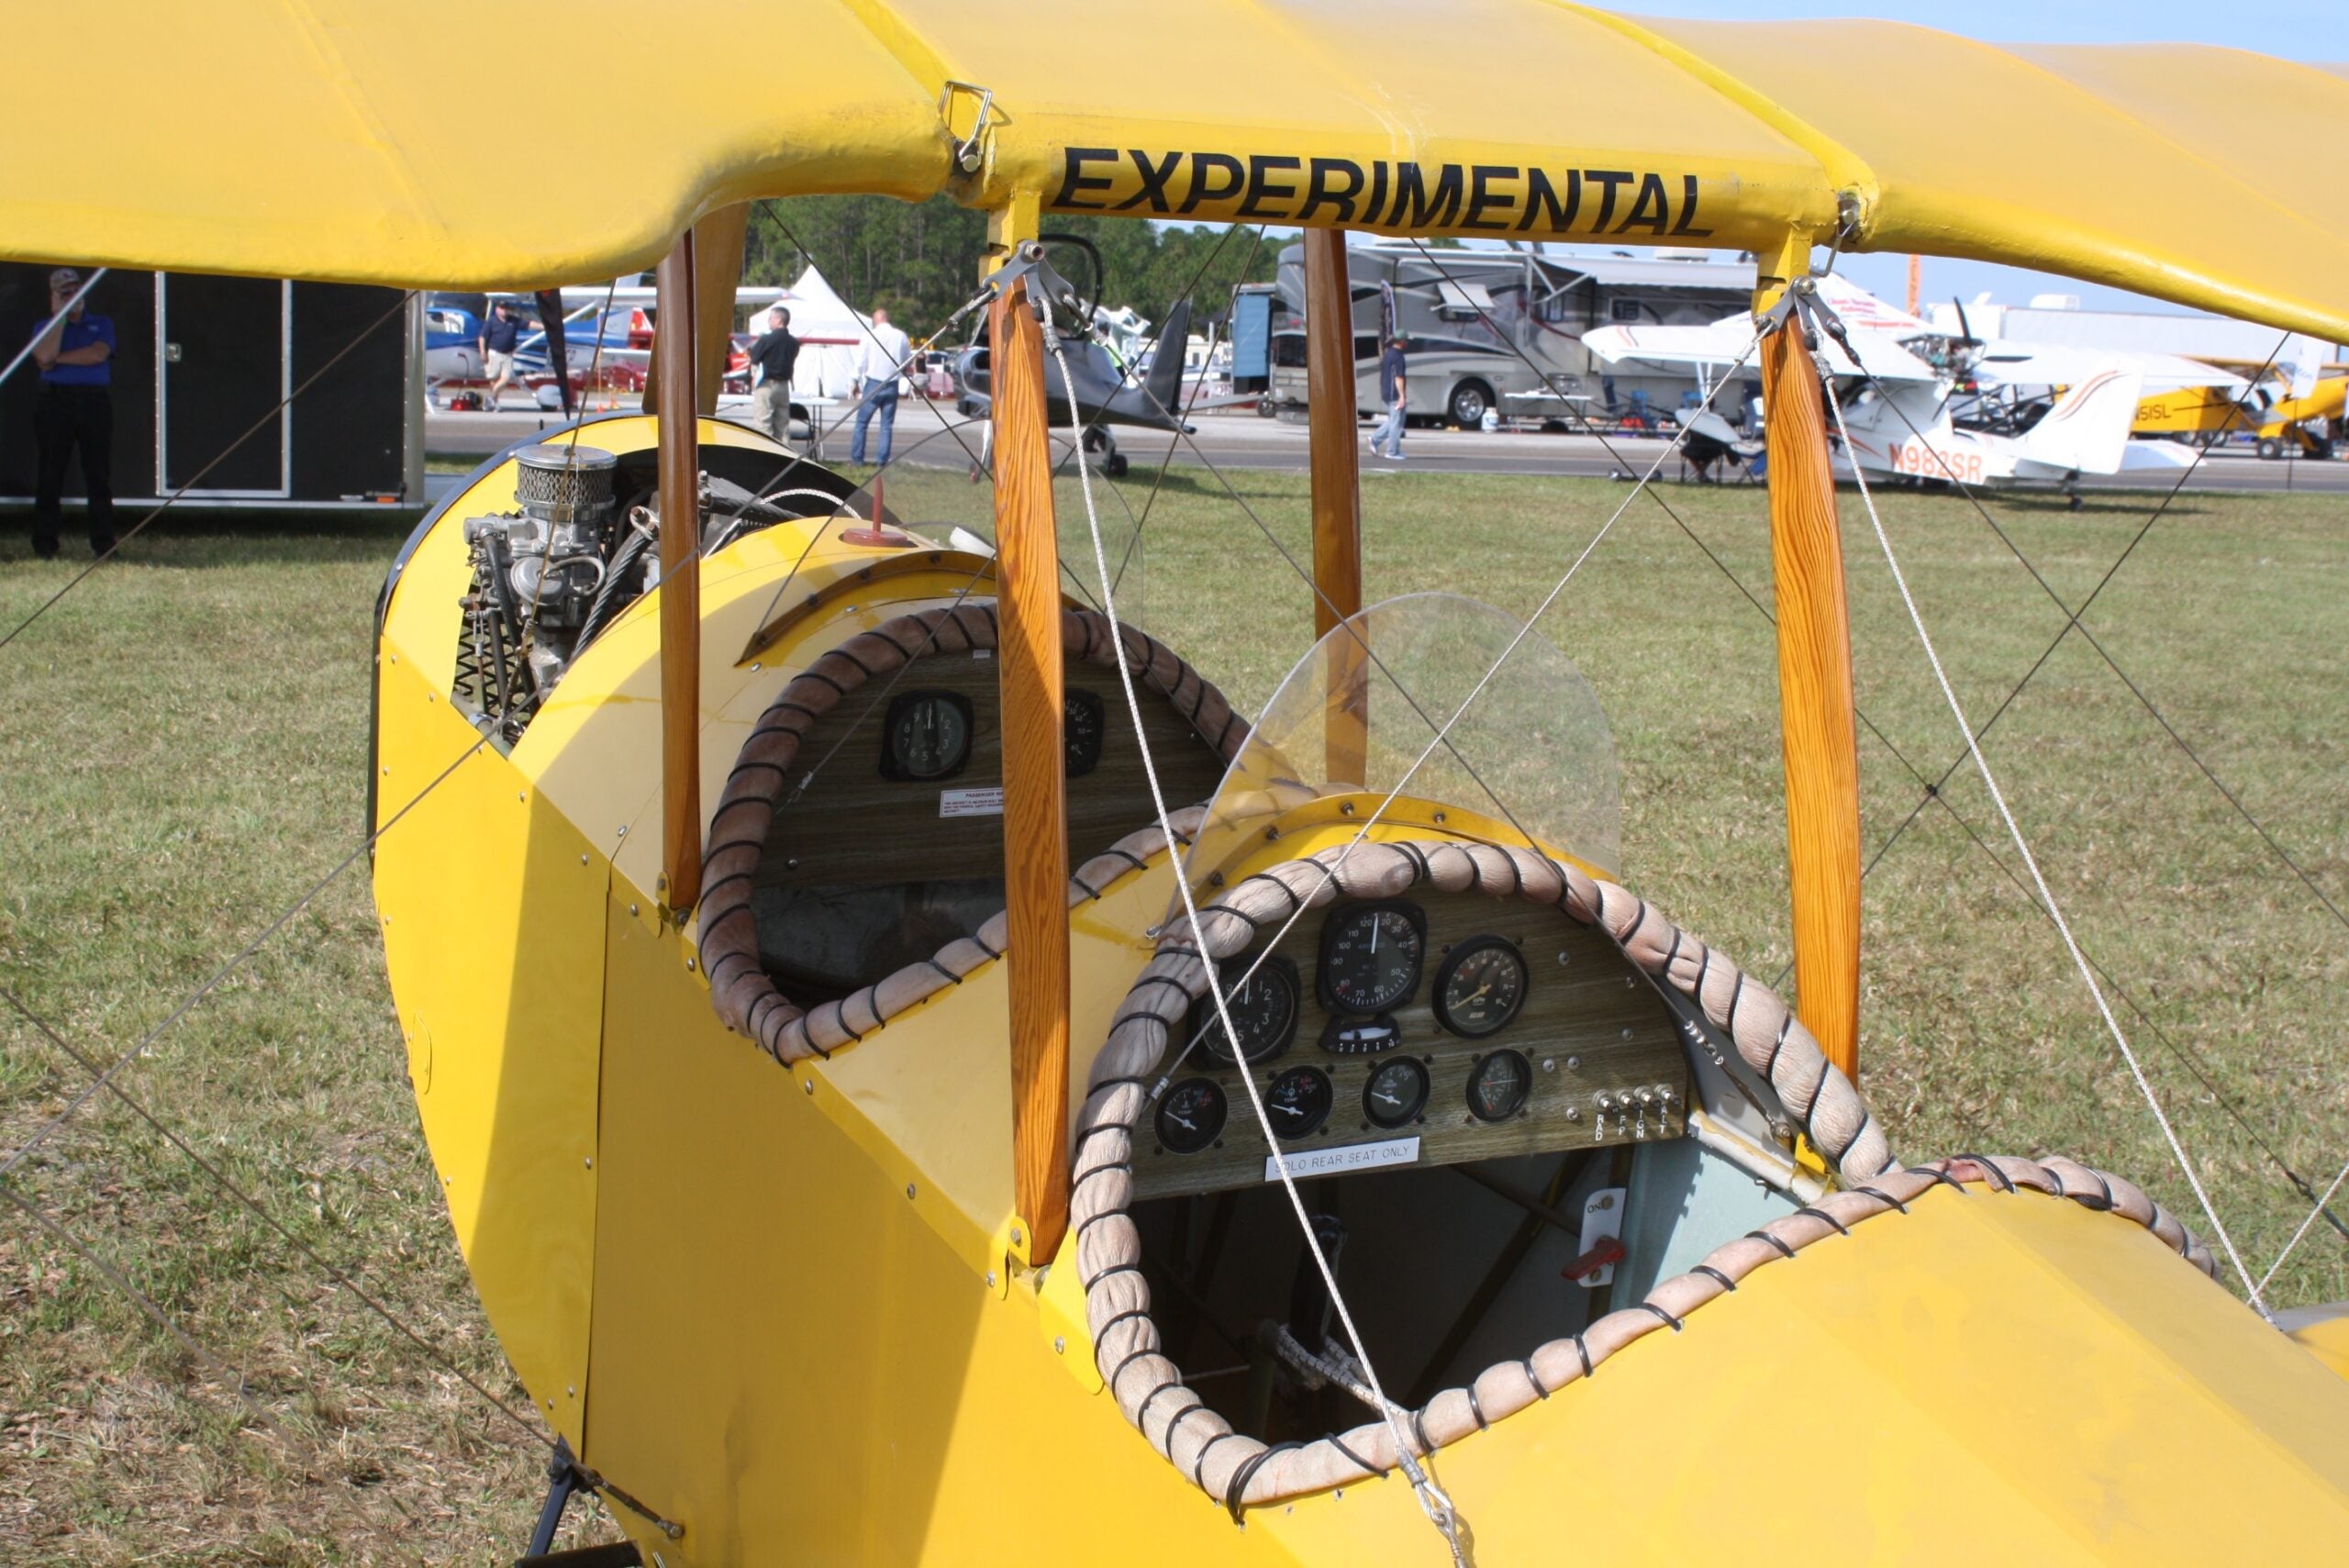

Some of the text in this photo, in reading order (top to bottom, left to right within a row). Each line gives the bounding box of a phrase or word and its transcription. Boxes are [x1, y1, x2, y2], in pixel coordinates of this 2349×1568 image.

[1052, 147, 1715, 238] EXPERIMENTAL
[1888, 442, 1982, 483] N982SR
[913, 712, 920, 723] 9
[943, 719, 951, 729] 2
[903, 723, 911, 734] 8
[903, 738, 910, 748] 7
[941, 739, 949, 750] 3
[909, 748, 917, 758] 6
[921, 751, 929, 762] 5
[1264, 988, 1273, 1001] 2
[1262, 1013, 1270, 1025] 3
[1252, 1022, 1260, 1035] 4
[1237, 1029, 1245, 1042] 5
[1636, 1109, 1644, 1139] IGN
[1659, 1105, 1668, 1134] ALT
[1595, 1114, 1605, 1141] RAD
[1311, 1154, 1342, 1168] REAR
[1348, 1150, 1377, 1163] SEAT
[1382, 1146, 1410, 1159] ONLY
